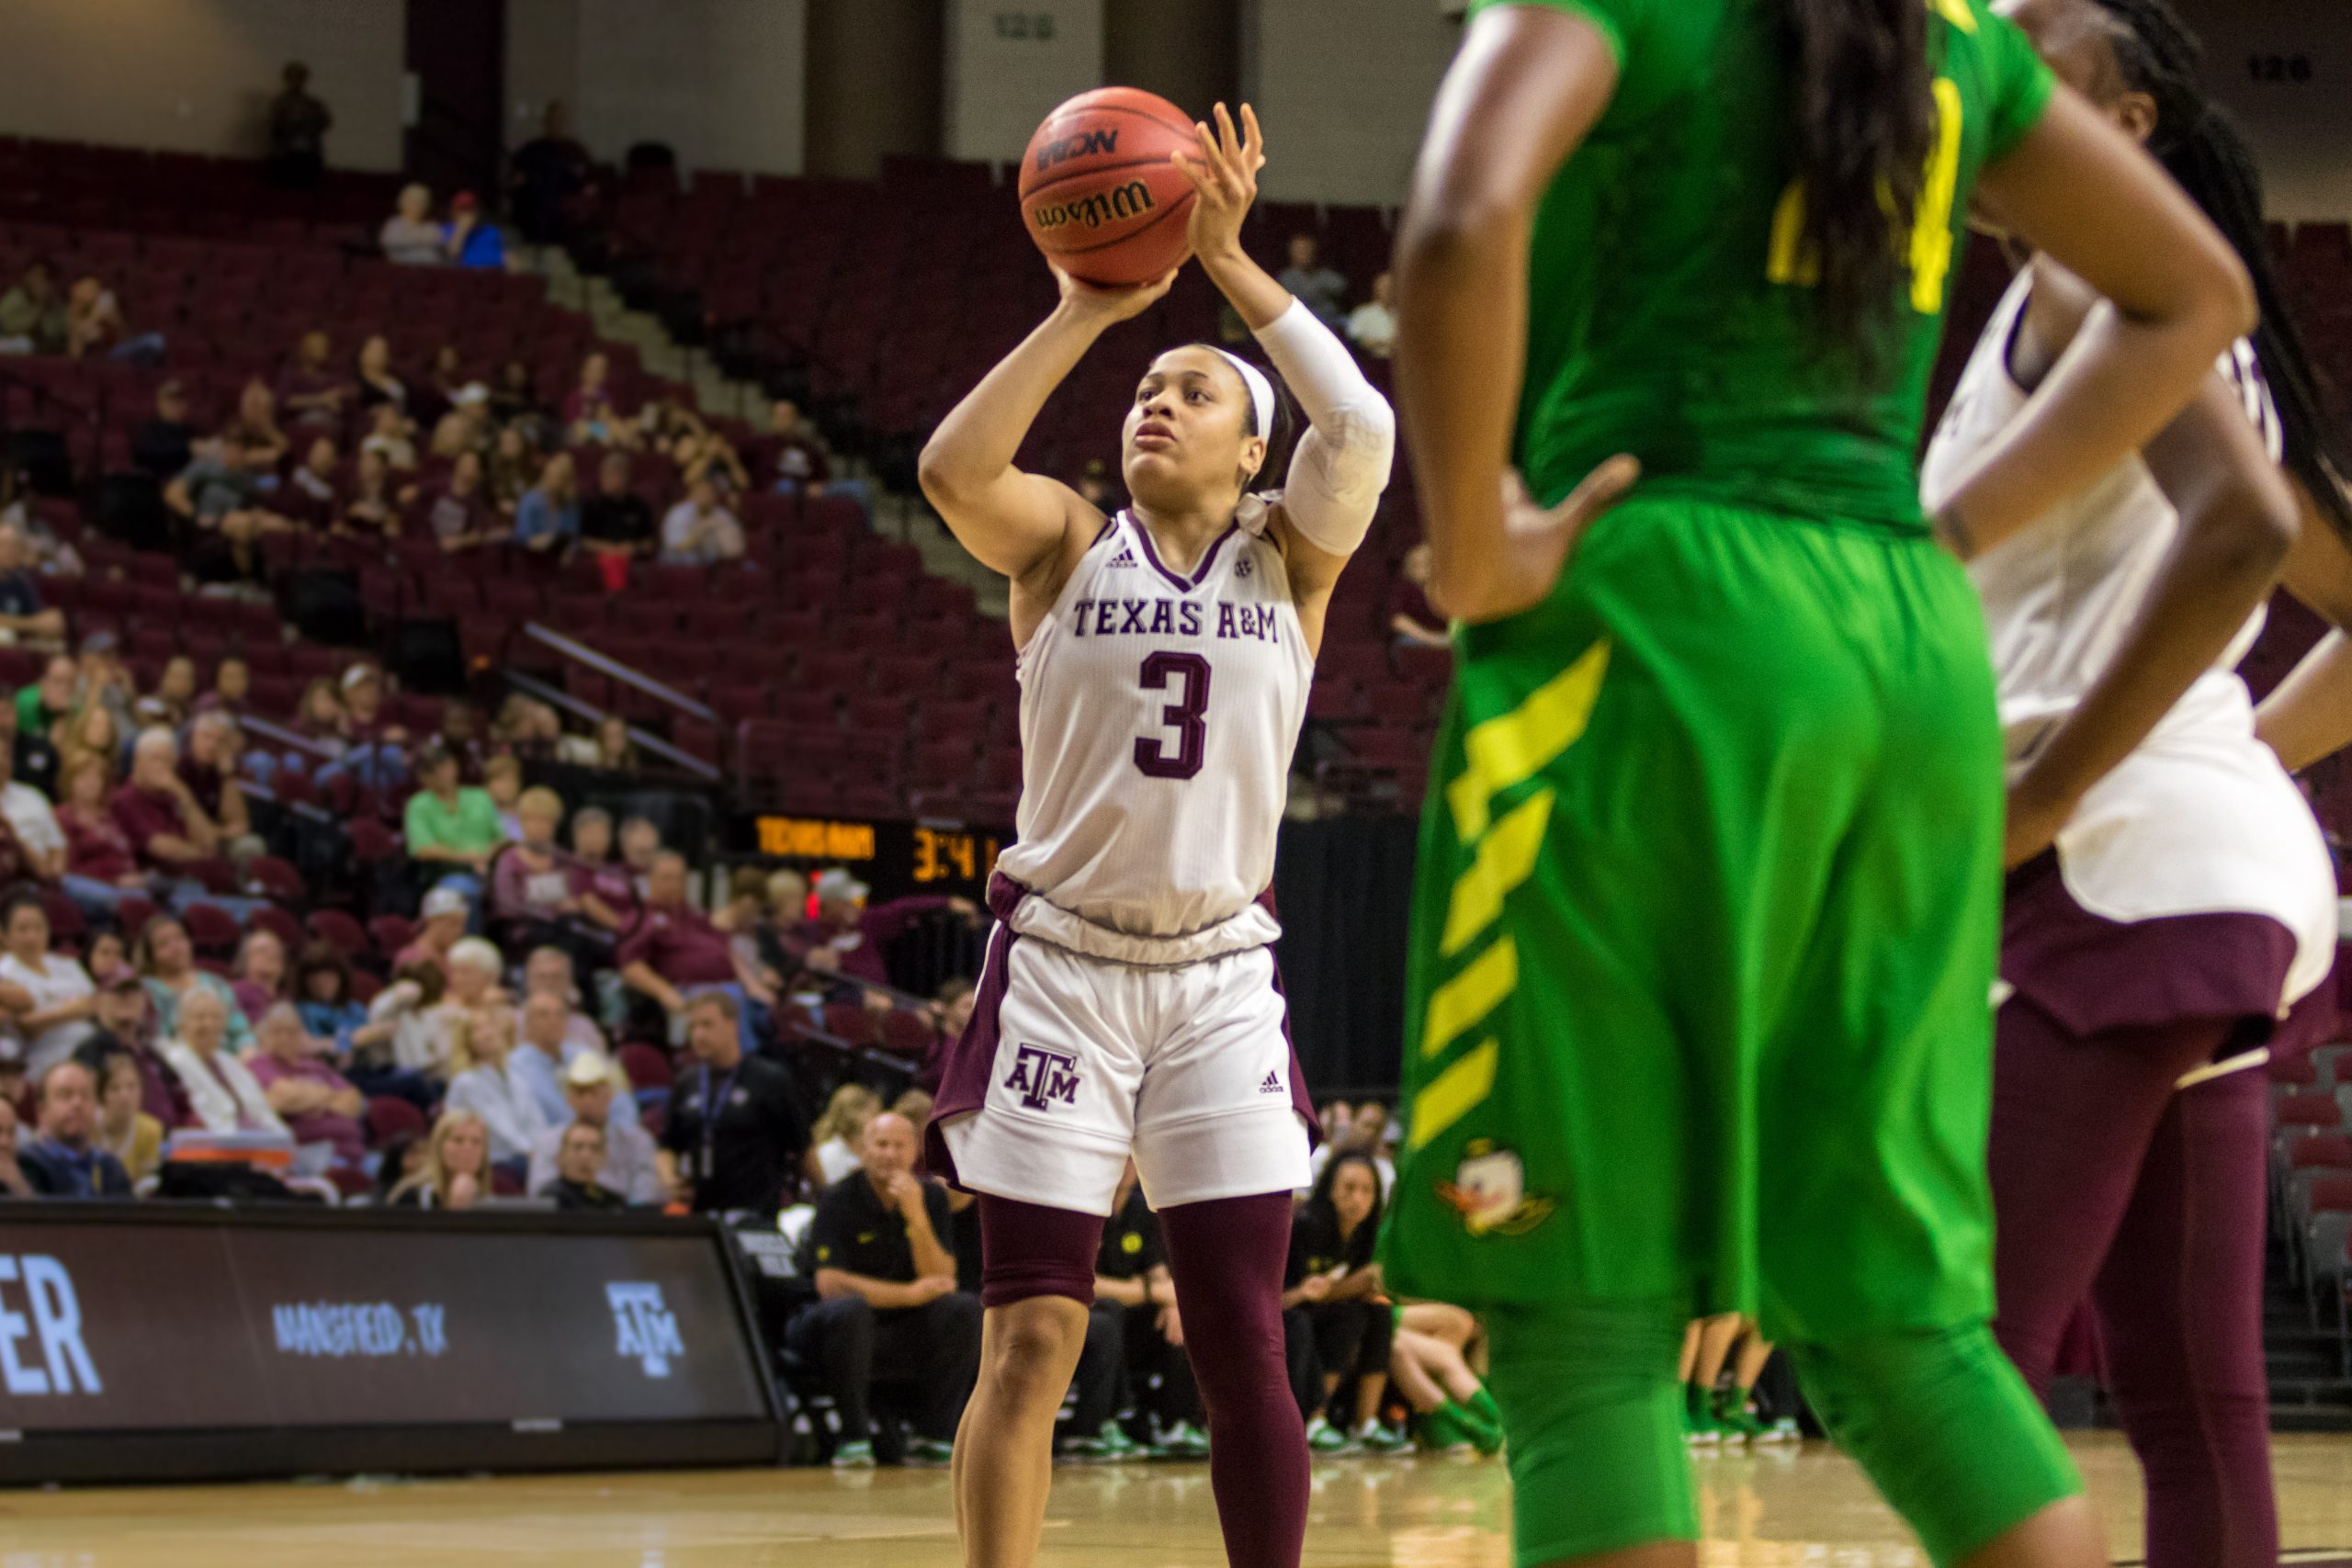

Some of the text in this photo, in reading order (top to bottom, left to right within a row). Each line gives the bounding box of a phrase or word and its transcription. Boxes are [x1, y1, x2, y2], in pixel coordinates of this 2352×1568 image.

[1035, 180, 1155, 229] Wilson
[1074, 598, 1279, 643] TEXAS A&M
[1134, 650, 1212, 780] 3
[0, 1253, 104, 1395] ER
